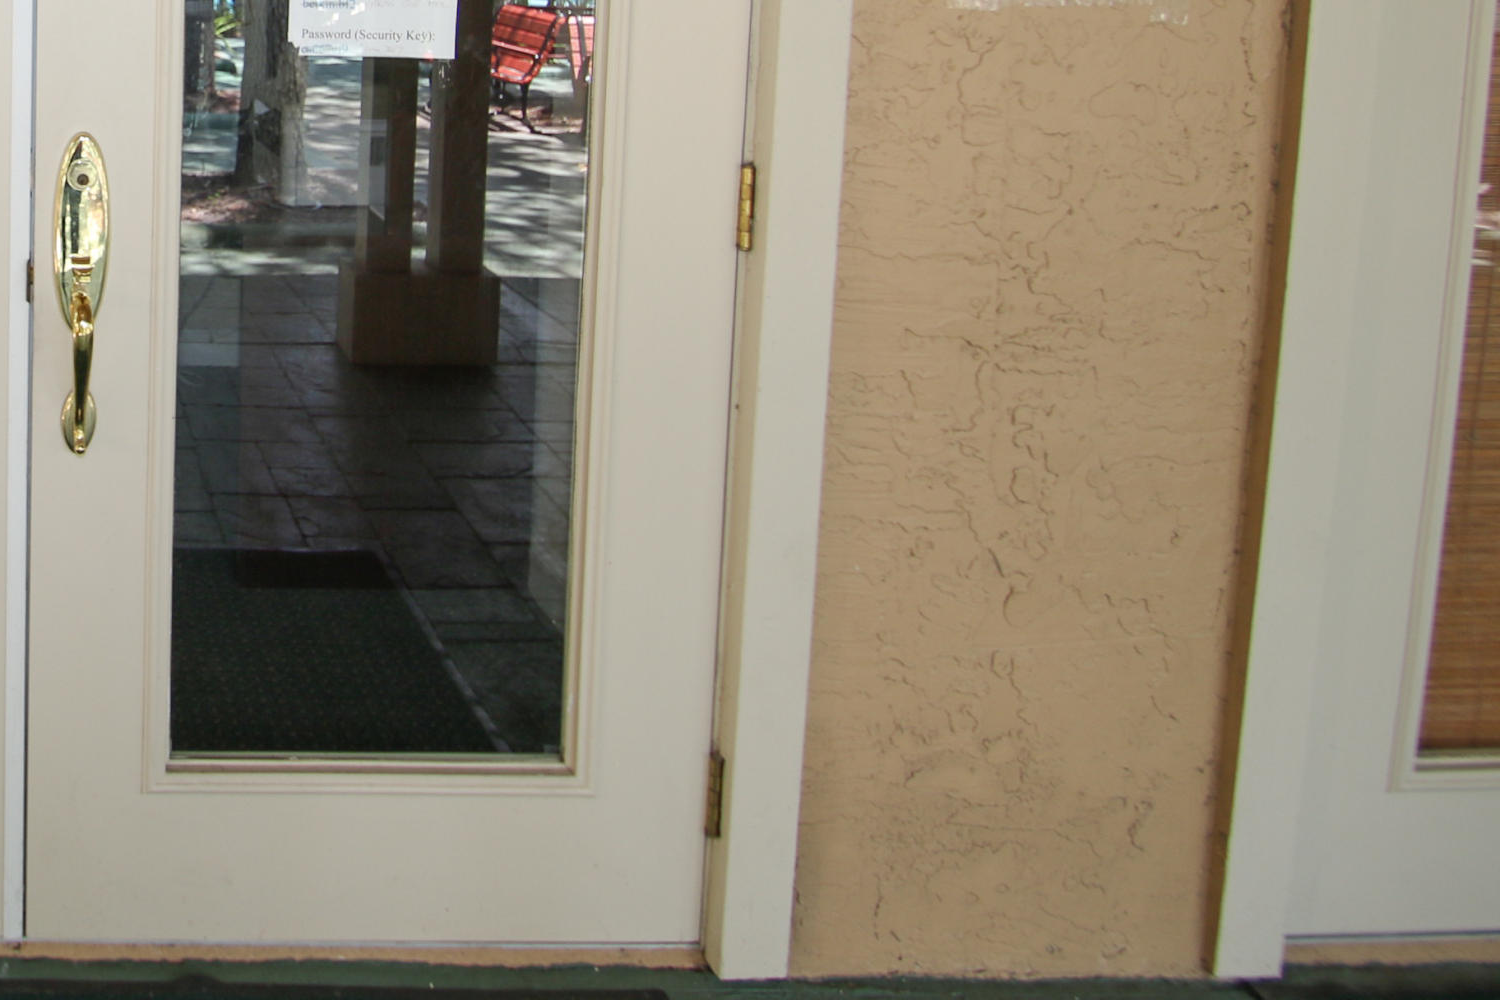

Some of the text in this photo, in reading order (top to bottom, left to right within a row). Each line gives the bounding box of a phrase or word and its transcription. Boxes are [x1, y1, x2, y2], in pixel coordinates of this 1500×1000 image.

[301, 28, 436, 43] Password (Security Key):
